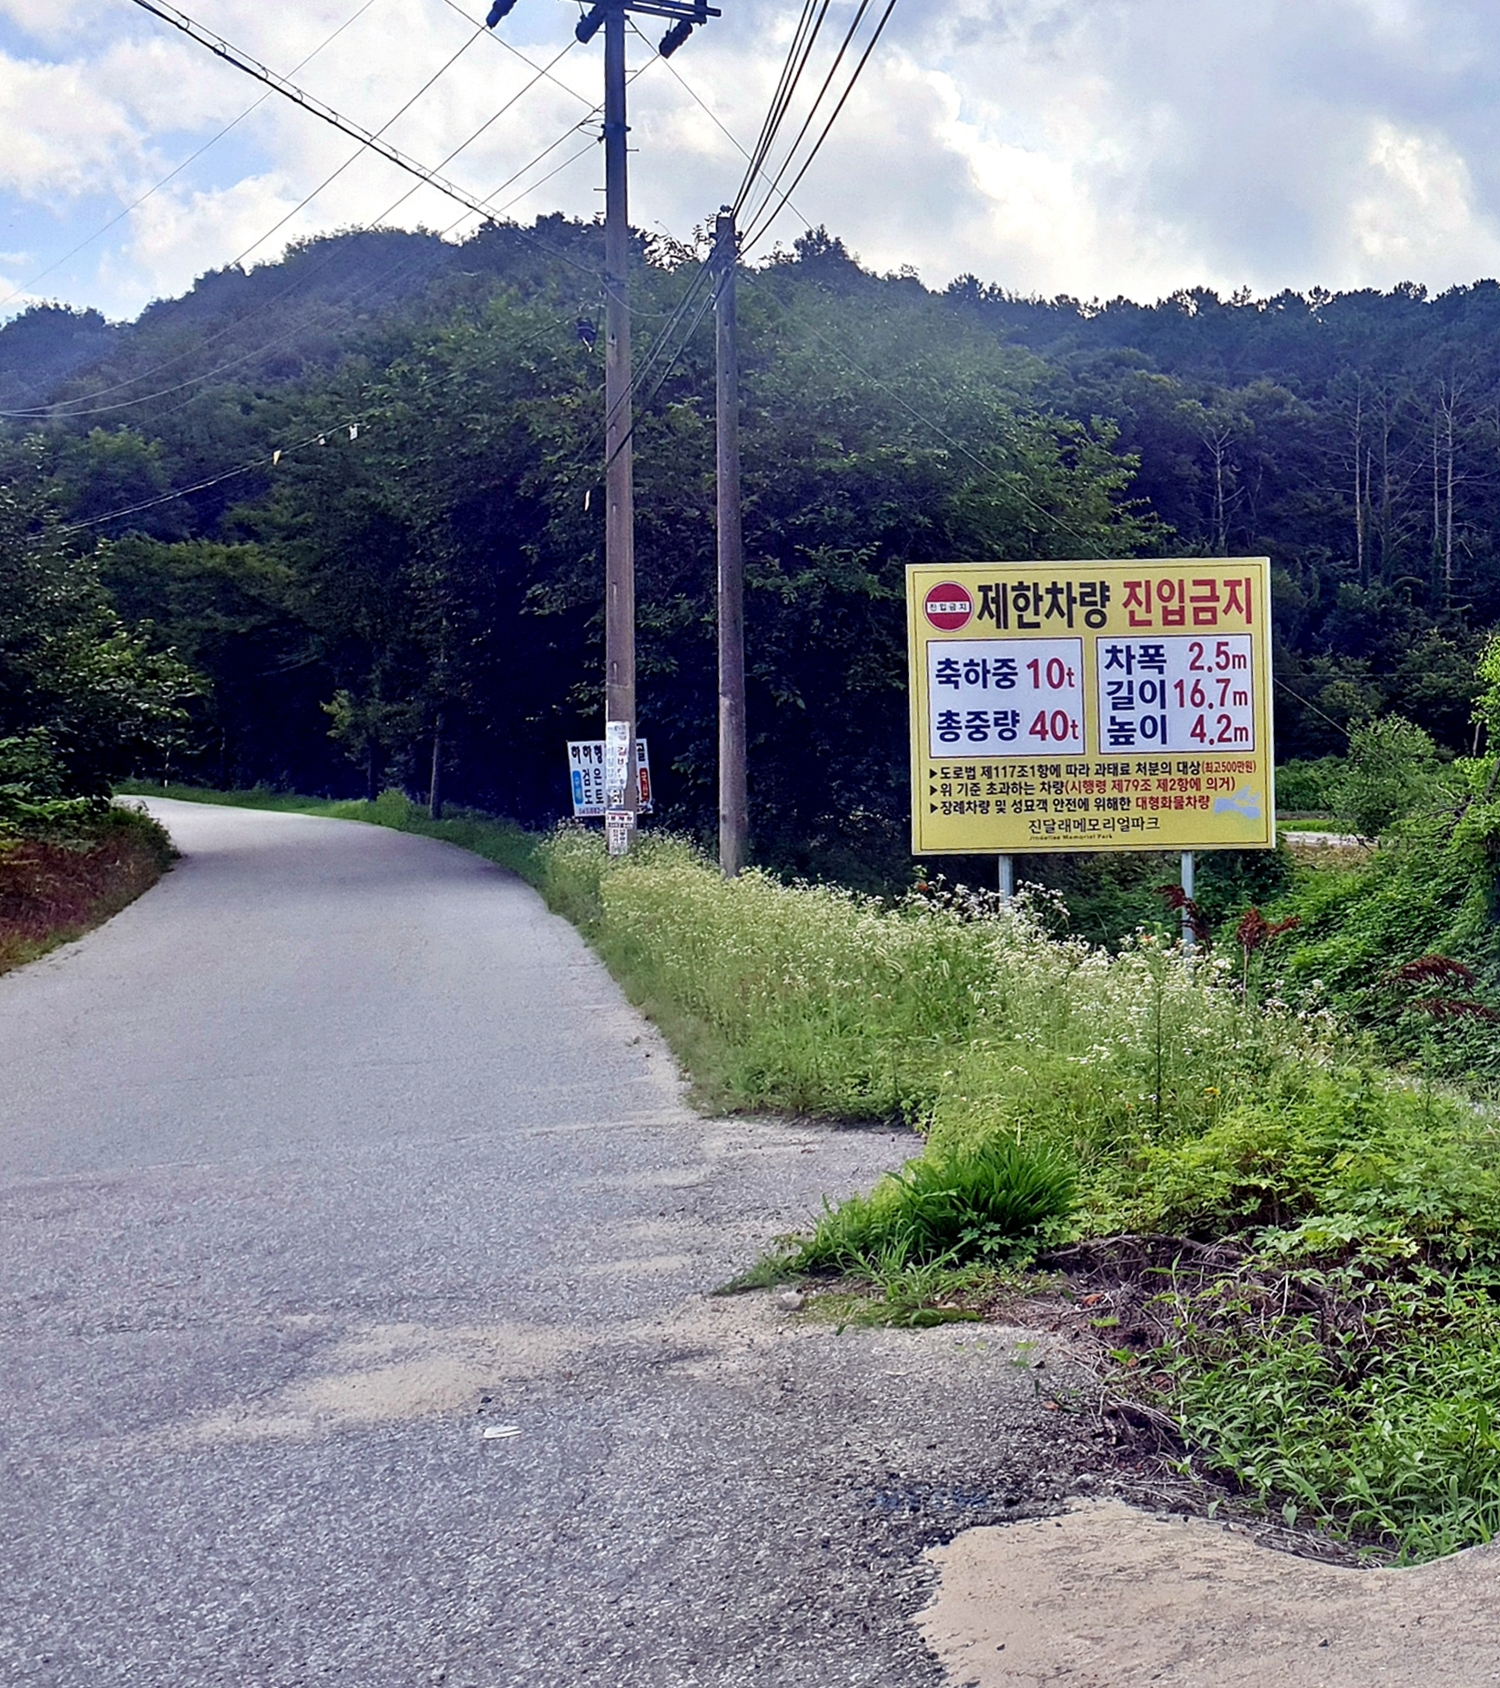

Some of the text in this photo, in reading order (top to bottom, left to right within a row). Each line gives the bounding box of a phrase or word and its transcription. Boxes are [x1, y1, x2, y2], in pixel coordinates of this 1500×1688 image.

[929, 602, 968, 612] 진입금지
[977, 577, 1253, 629] 제한차량 진입금지
[935, 658, 1076, 690] 축하중 10t
[1104, 641, 1248, 675] 차폭 2.5m
[1106, 678, 1249, 711] 길이 16.7m
[936, 710, 1080, 742] 총중량 40t
[1107, 714, 1249, 746] 높이 4.2m
[940, 766, 977, 781] 도로법
[980, 764, 1062, 780] 제117조1항에
[1066, 763, 1091, 778] 따라
[1094, 762, 1131, 777] 과태료
[1135, 761, 1172, 776] 처분의
[940, 782, 952, 797] 위
[957, 782, 982, 797] 기준
[985, 781, 1036, 796] 초과하는
[1111, 778, 1152, 794] 제79조
[1156, 777, 1202, 792] 제2항에
[1206, 776, 1236, 791] 의거)
[940, 795, 1210, 816] 장례차량 및 성묘객 안전에 위해한 대형화물차량
[1028, 816, 1161, 834] 진달래메모리얼파크
